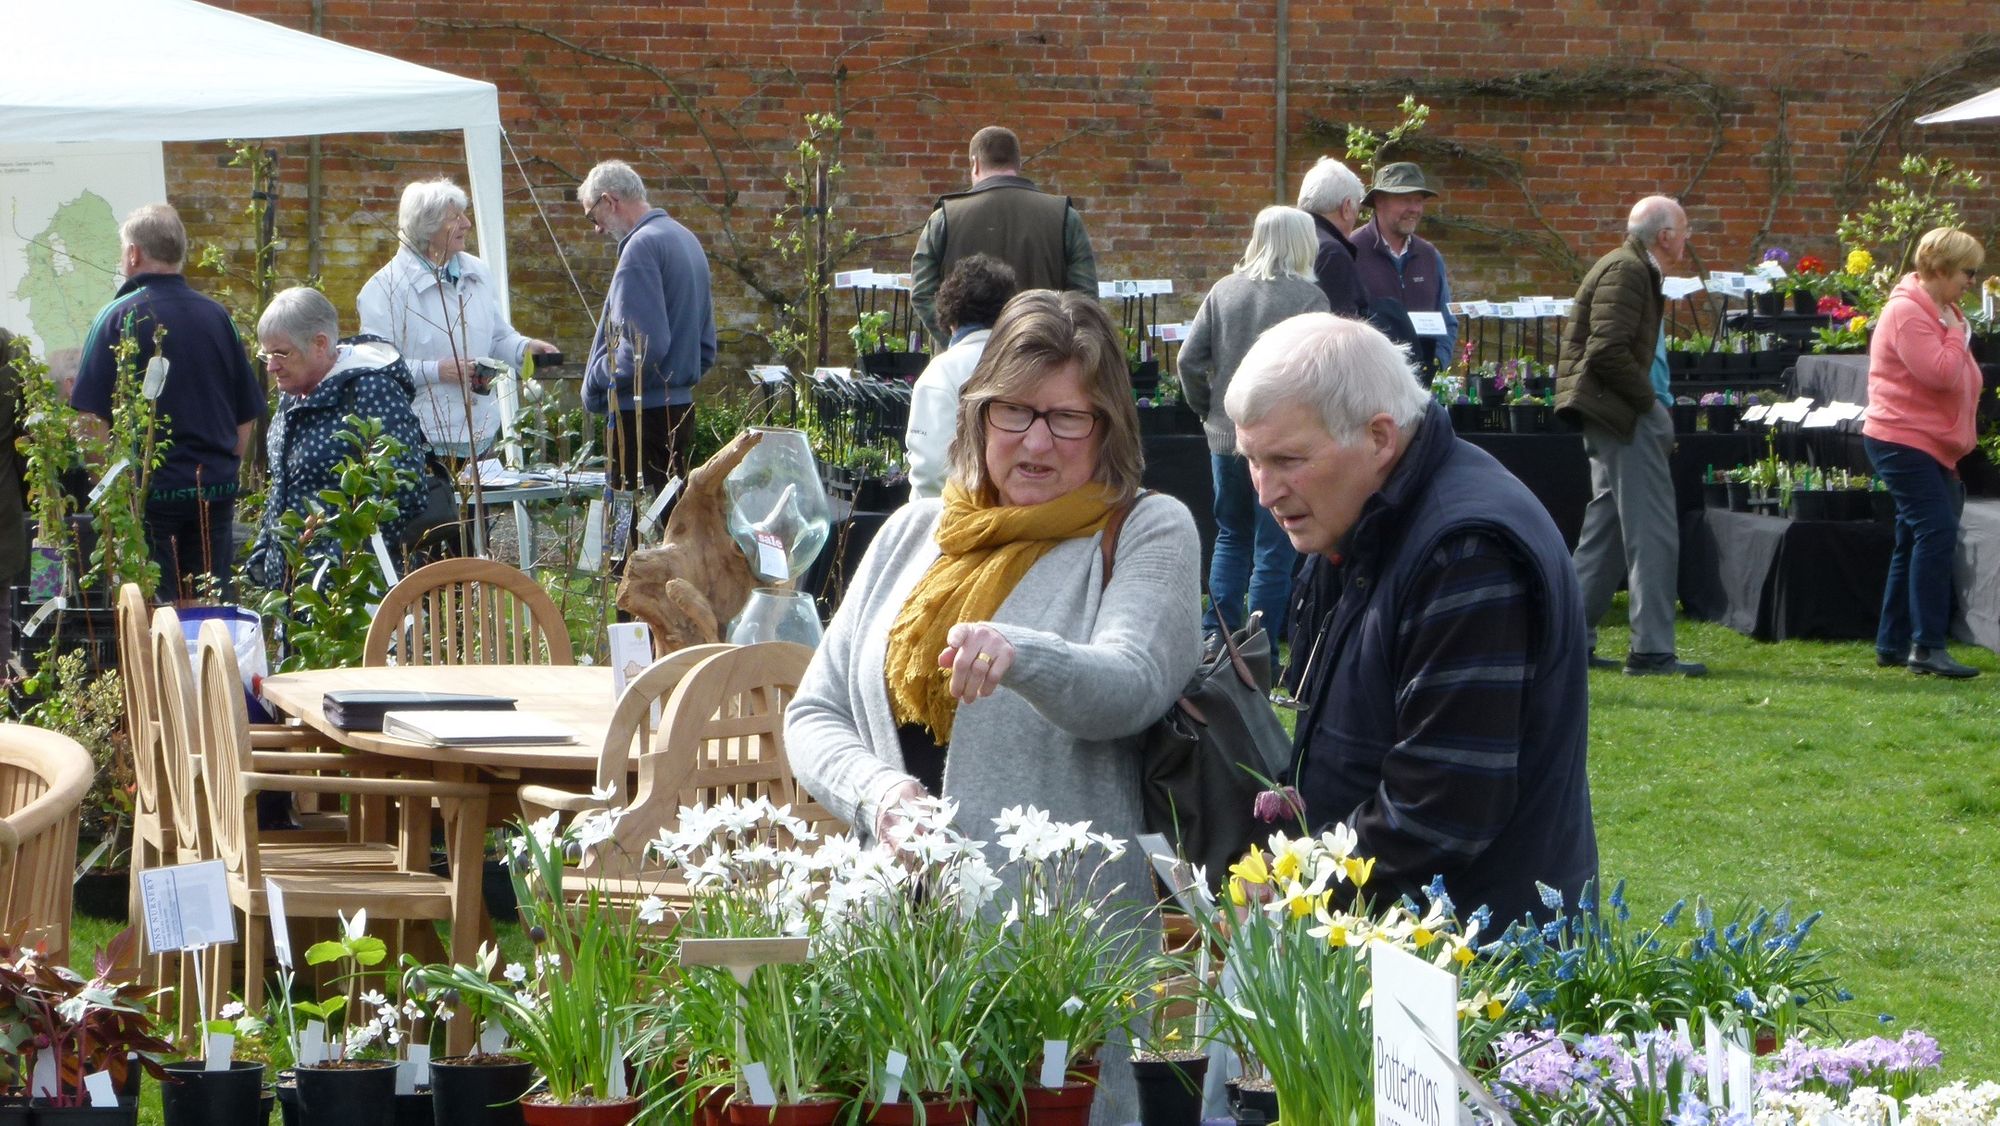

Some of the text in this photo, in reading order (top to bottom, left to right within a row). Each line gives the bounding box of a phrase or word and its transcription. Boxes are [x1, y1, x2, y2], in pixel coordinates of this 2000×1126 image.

[758, 533, 783, 549] sale
[146, 879, 159, 922] NURSERY
[1377, 1035, 1440, 1126] Pottertons
